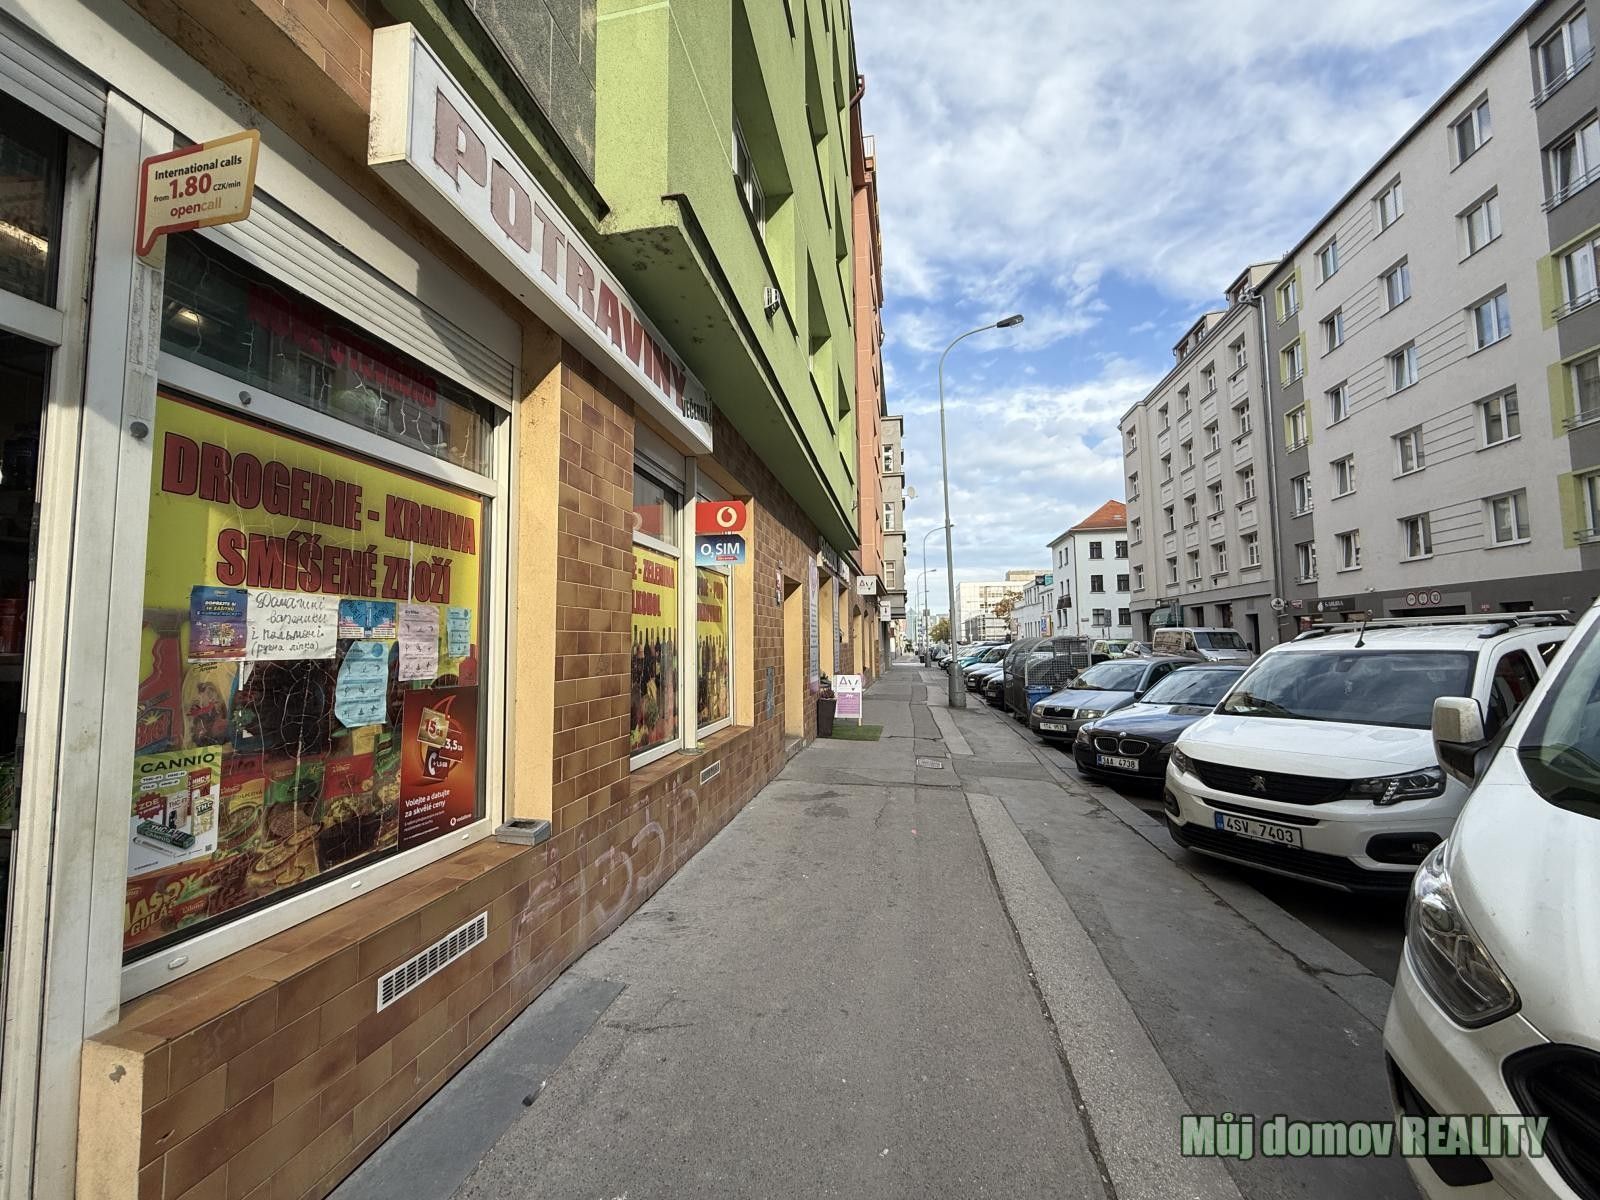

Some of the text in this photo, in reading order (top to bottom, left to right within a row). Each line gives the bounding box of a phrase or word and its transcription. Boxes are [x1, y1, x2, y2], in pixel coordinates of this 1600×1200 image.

[155, 155, 242, 180] International calls
[169, 172, 212, 199] 1.80
[213, 180, 241, 191] CZK/min
[170, 197, 222, 218] opencall
[434, 86, 686, 410] POTRAVINY
[162, 431, 476, 556] DROGERIE - KRMIVA
[715, 542, 740, 555] SIM
[216, 527, 379, 599] SMÍŠENÉ
[445, 738, 458, 751] 3,5
[141, 753, 215, 773] CANNIO
[137, 798, 159, 809] ZDE
[404, 809, 413, 818] za
[413, 803, 432, 816] skvělé
[432, 799, 446, 810] ceny
[405, 796, 426, 807] Volejte
[431, 789, 450, 800] datujte
[1226, 818, 1293, 843] 4SV 7403
